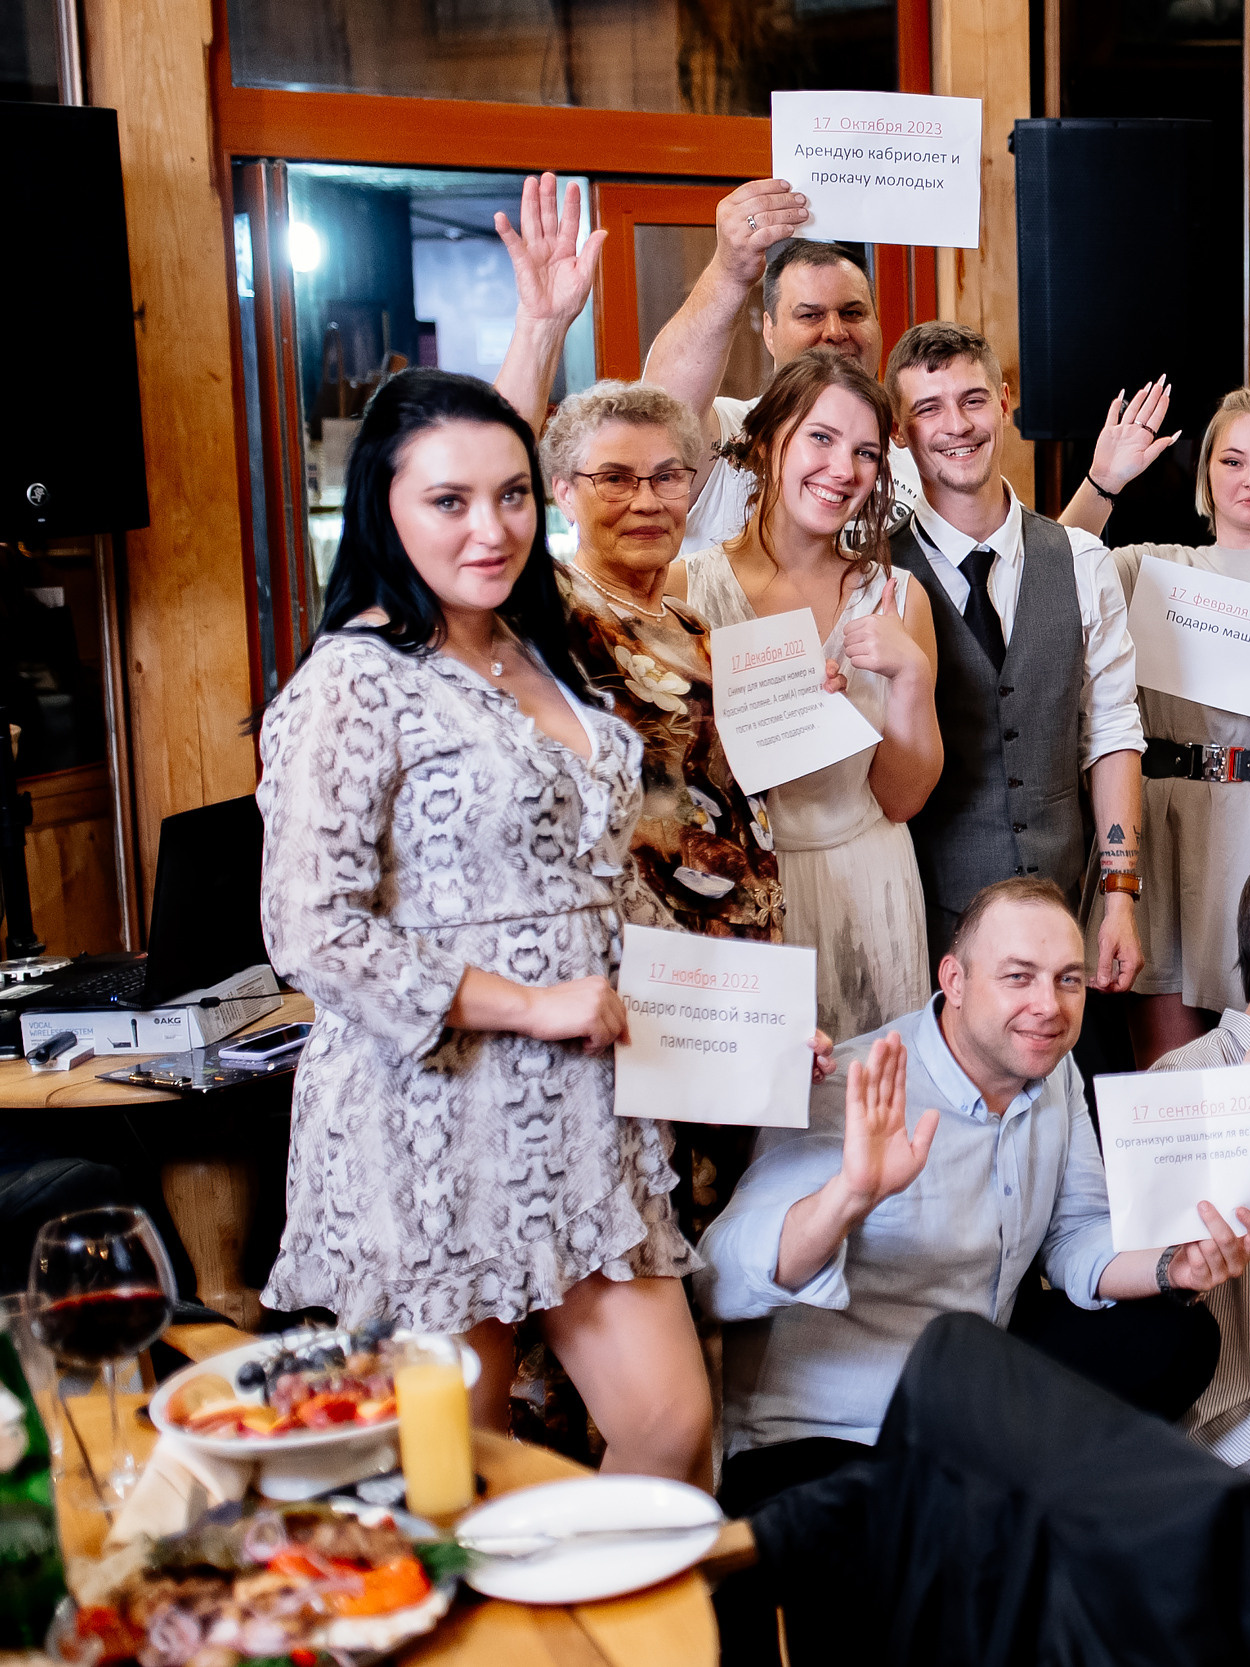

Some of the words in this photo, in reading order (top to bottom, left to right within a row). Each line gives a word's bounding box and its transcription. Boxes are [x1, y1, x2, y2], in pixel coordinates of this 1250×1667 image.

[813, 117, 831, 129] 17
[840, 117, 902, 134] Октября
[907, 121, 943, 135] 2023
[795, 144, 864, 160] Арендую
[868, 147, 947, 163] кабриолет
[951, 155, 960, 164] и
[811, 172, 871, 187] прокачу
[875, 175, 944, 190] молодых
[1171, 587, 1186, 599] 17
[1193, 592, 1249, 617] февраля
[1166, 609, 1220, 634] Подарю
[731, 656, 741, 670] 17
[744, 646, 782, 668] Декабря
[784, 639, 805, 657] 2022
[728, 686, 746, 697] Сниму
[747, 682, 758, 692] для
[759, 675, 786, 688] молодых
[787, 671, 807, 682] номер
[808, 667, 816, 675] на
[723, 702, 748, 718] Красной
[773, 693, 777, 702] А
[797, 686, 818, 697] приеду
[736, 724, 751, 735] гости
[752, 721, 757, 729] в
[758, 714, 784, 728] костюме
[784, 704, 818, 720] Снегурочки
[756, 734, 781, 748] подарю
[782, 723, 815, 739] подарочки
[650, 963, 665, 979] 17
[671, 969, 717, 987] ноября
[722, 972, 760, 989] 2022
[622, 995, 676, 1019] Подарю
[679, 1005, 739, 1022] годовой
[743, 1011, 786, 1026] запас
[660, 1035, 738, 1054] памперсов
[1132, 1106, 1148, 1120] 17
[1158, 1100, 1225, 1119] сентября
[1115, 1135, 1174, 1148] Организую
[1176, 1132, 1223, 1143] шашлыки
[1154, 1153, 1193, 1165] сегодня
[1195, 1151, 1207, 1161] на
[1210, 1147, 1248, 1160] свадьбе
